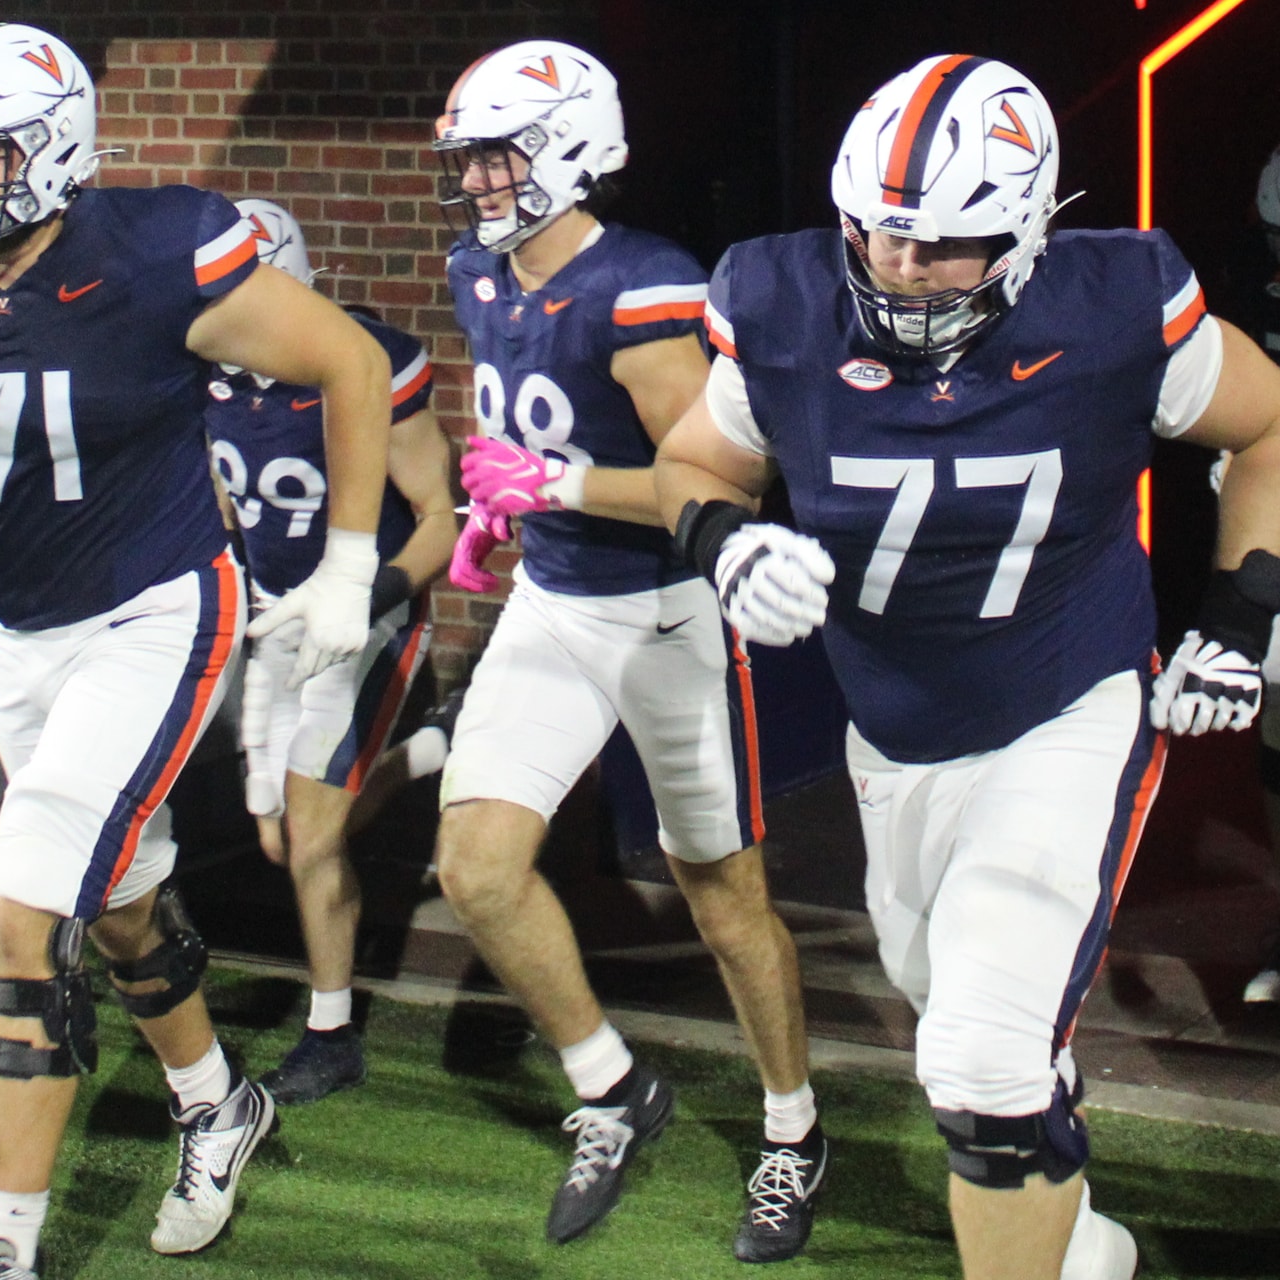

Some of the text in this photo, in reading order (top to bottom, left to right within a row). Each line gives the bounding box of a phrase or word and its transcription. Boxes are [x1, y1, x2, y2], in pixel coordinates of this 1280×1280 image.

[876, 215, 917, 231] ACC
[846, 365, 886, 380] ACC
[831, 448, 1063, 618] 77
